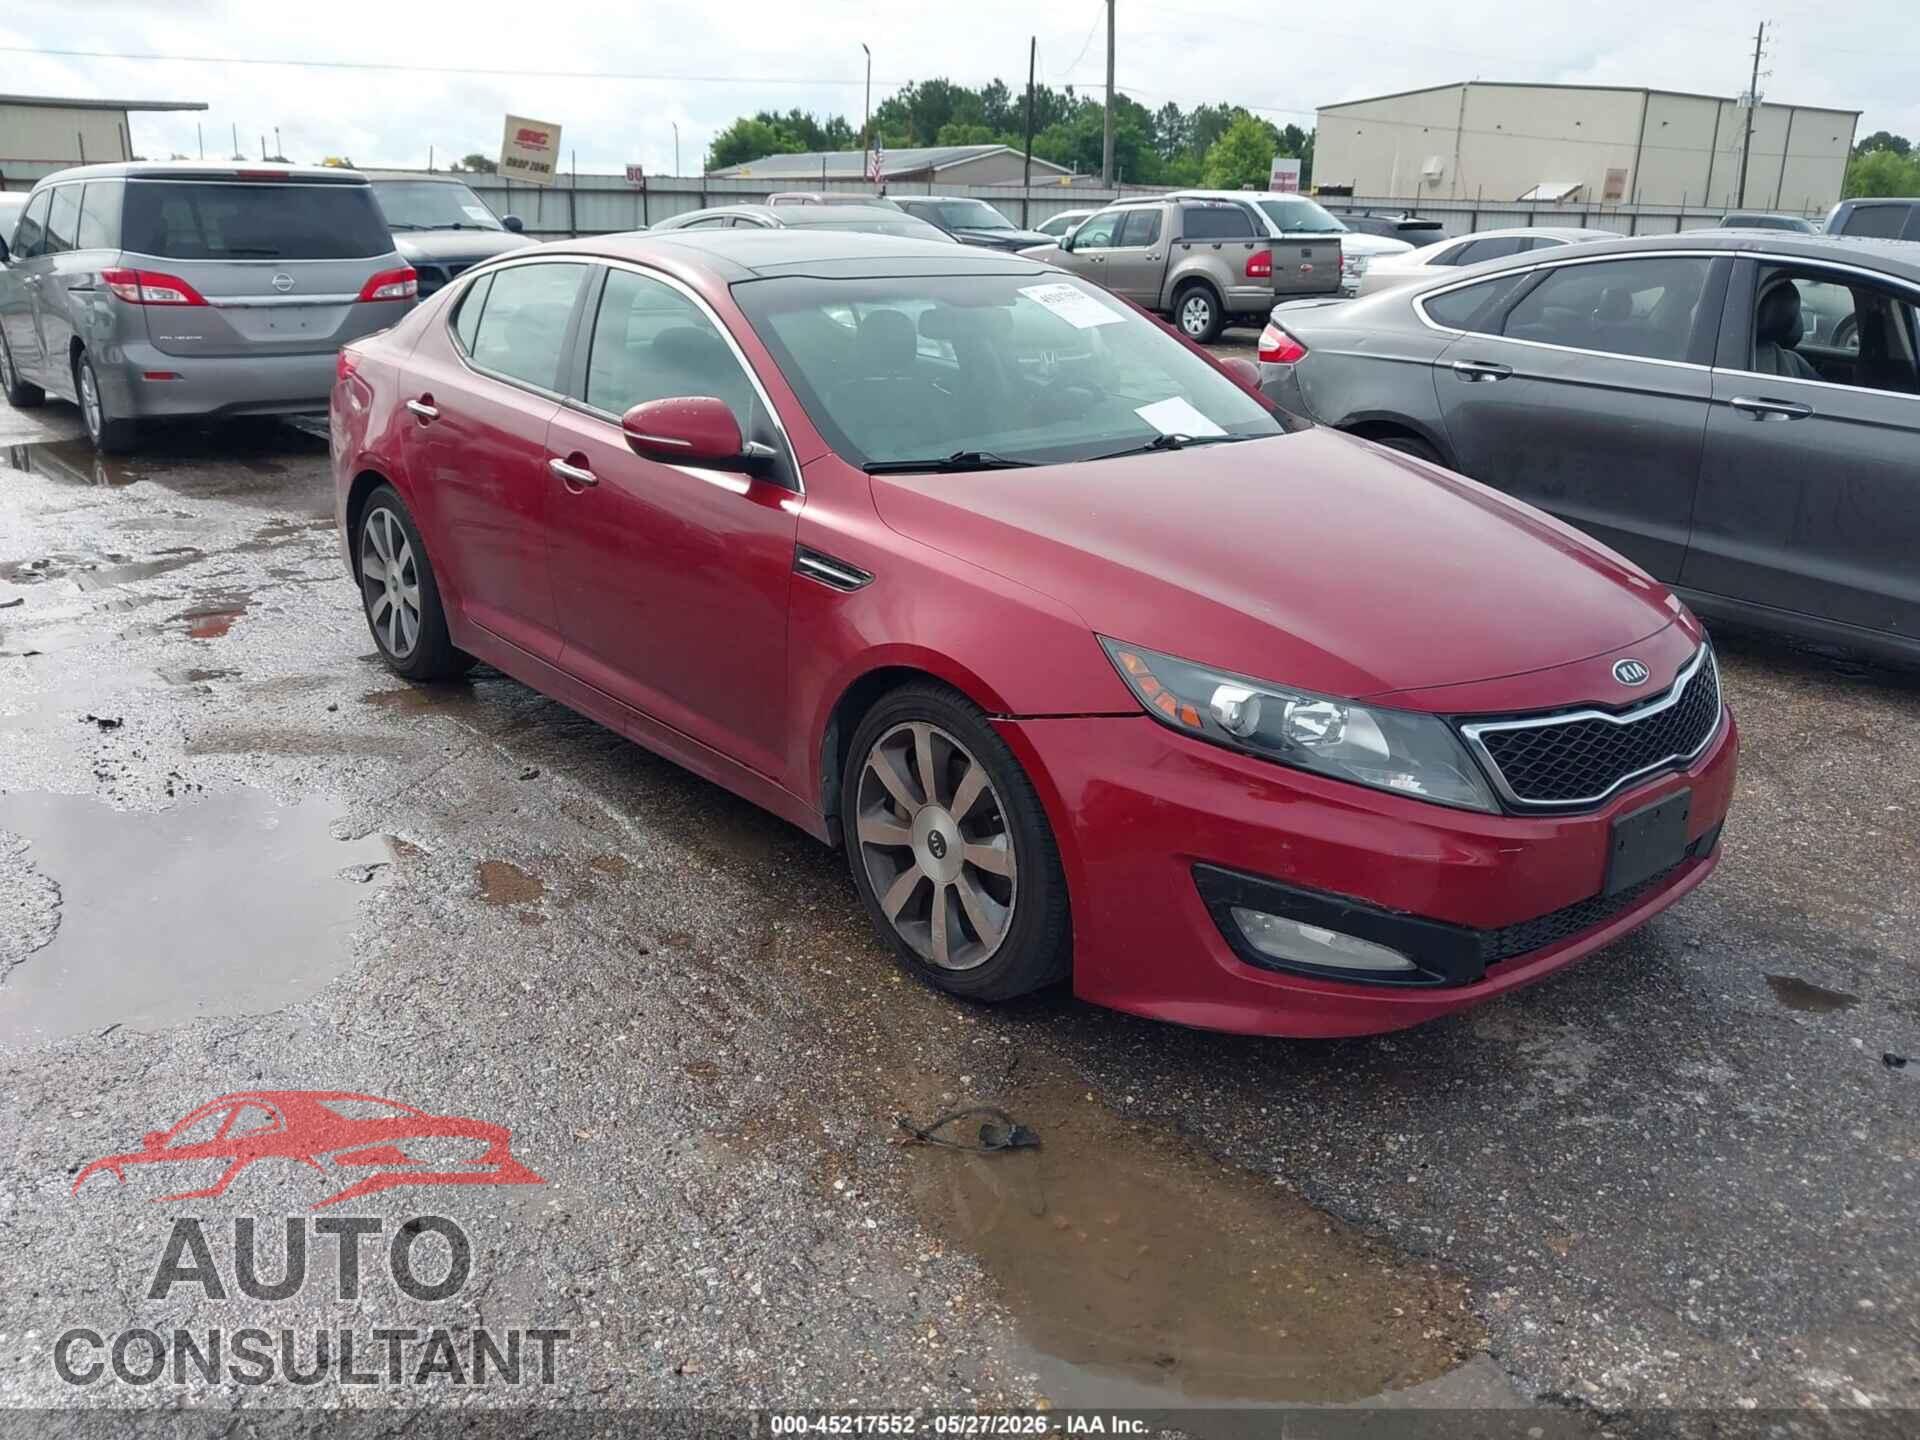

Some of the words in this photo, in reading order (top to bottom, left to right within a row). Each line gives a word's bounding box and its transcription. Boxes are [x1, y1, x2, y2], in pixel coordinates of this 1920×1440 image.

[506, 156, 529, 169] DROP
[529, 160, 551, 173] ZONE
[1618, 663, 1647, 681] KIA
